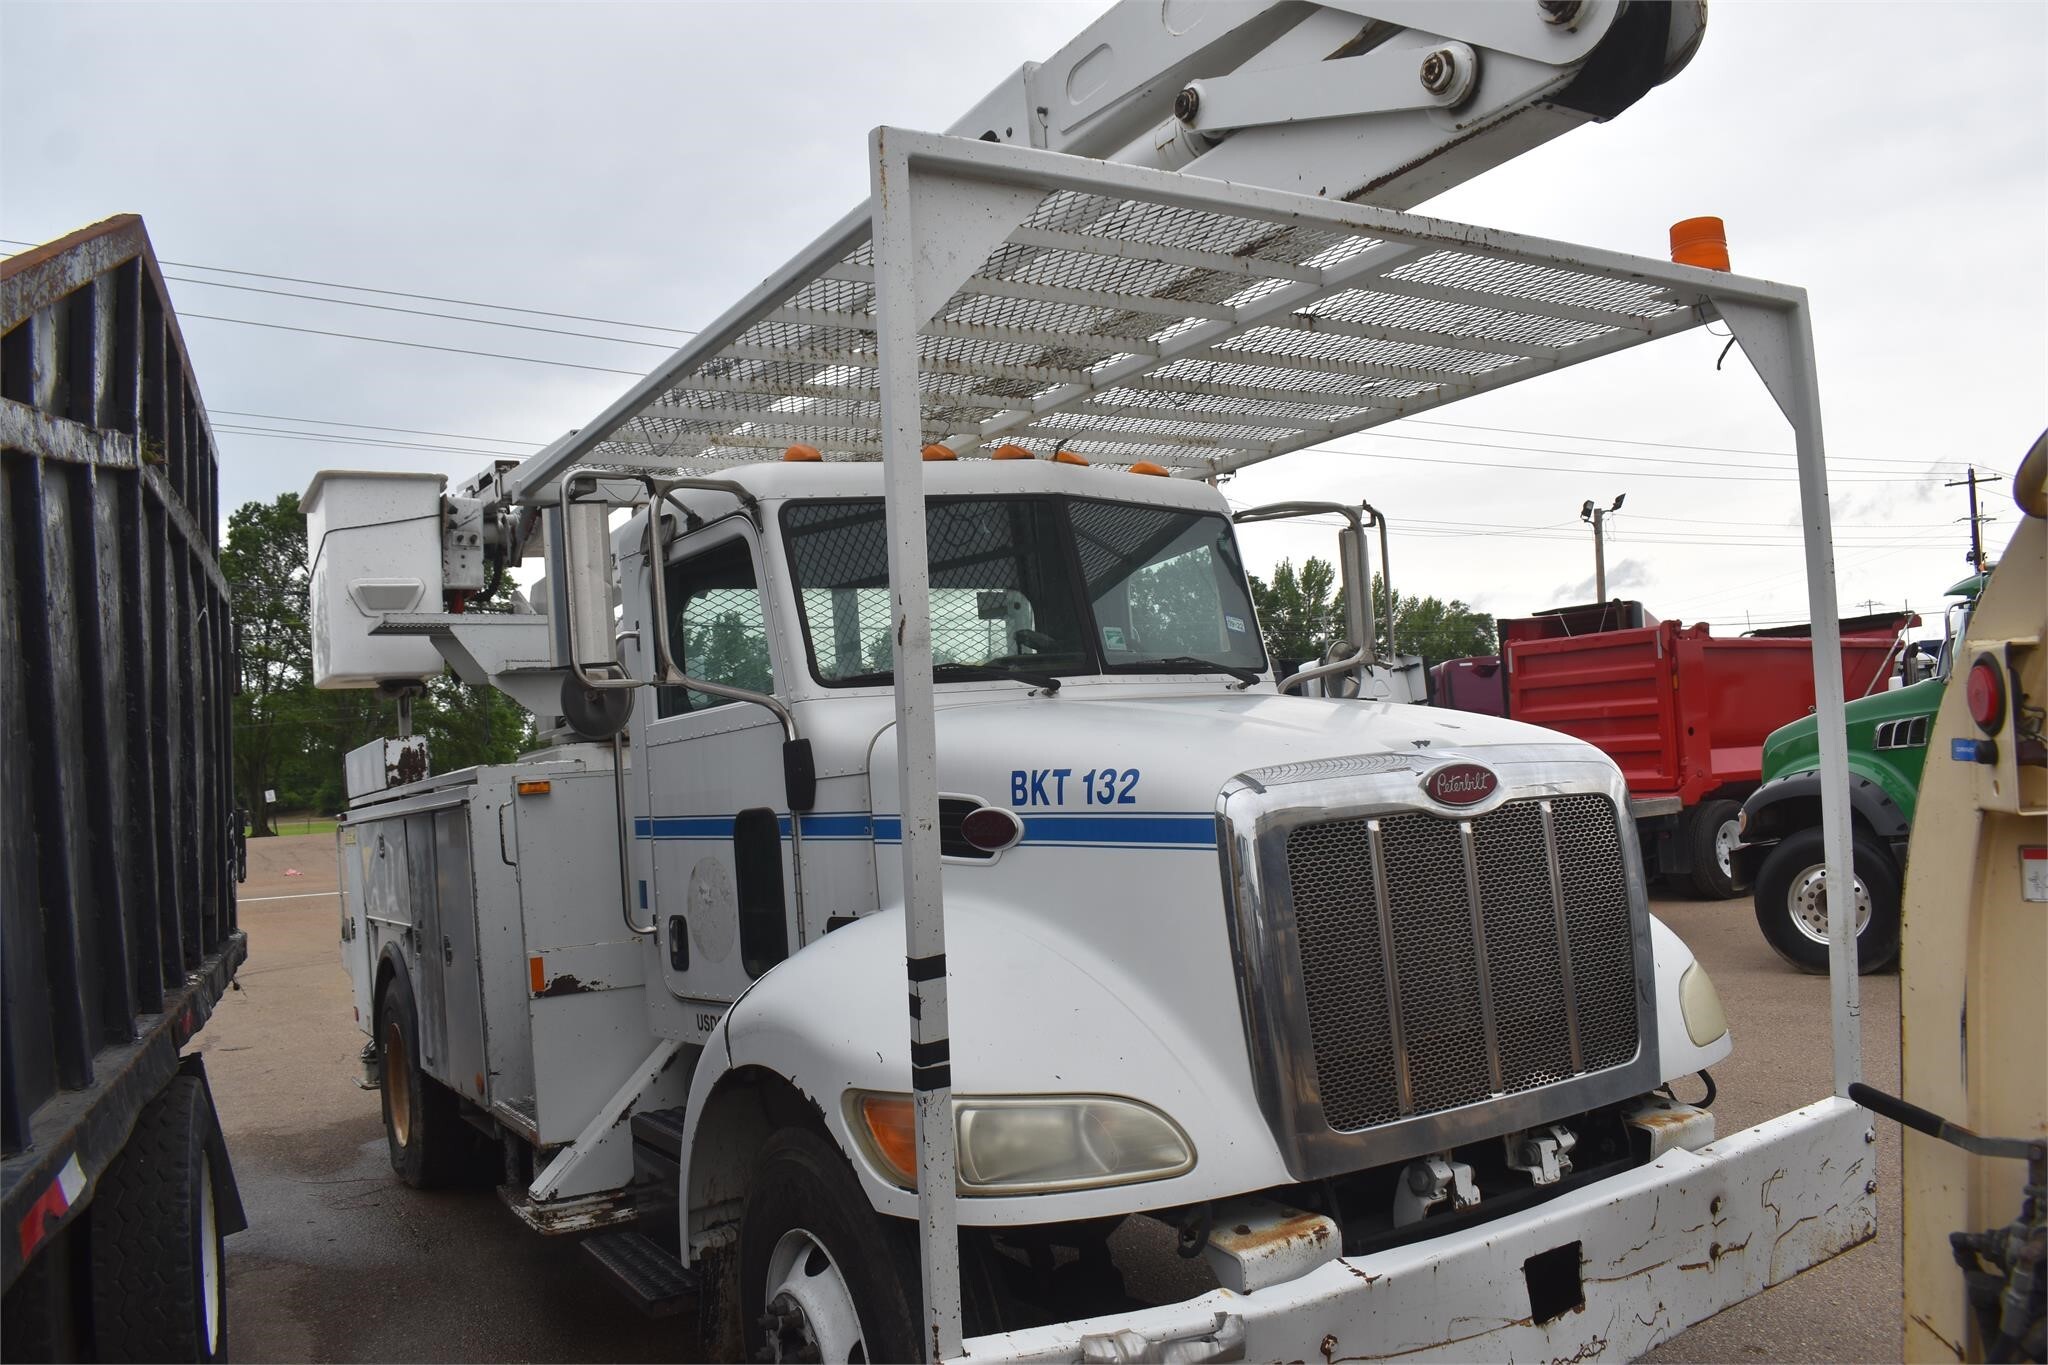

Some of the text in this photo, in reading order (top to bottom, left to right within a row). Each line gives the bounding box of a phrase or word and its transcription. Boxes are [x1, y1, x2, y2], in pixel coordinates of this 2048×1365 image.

[1011, 768, 1140, 806] BKT 132
[1437, 772, 1490, 796] Peterbilt
[696, 1013, 722, 1032] USD
